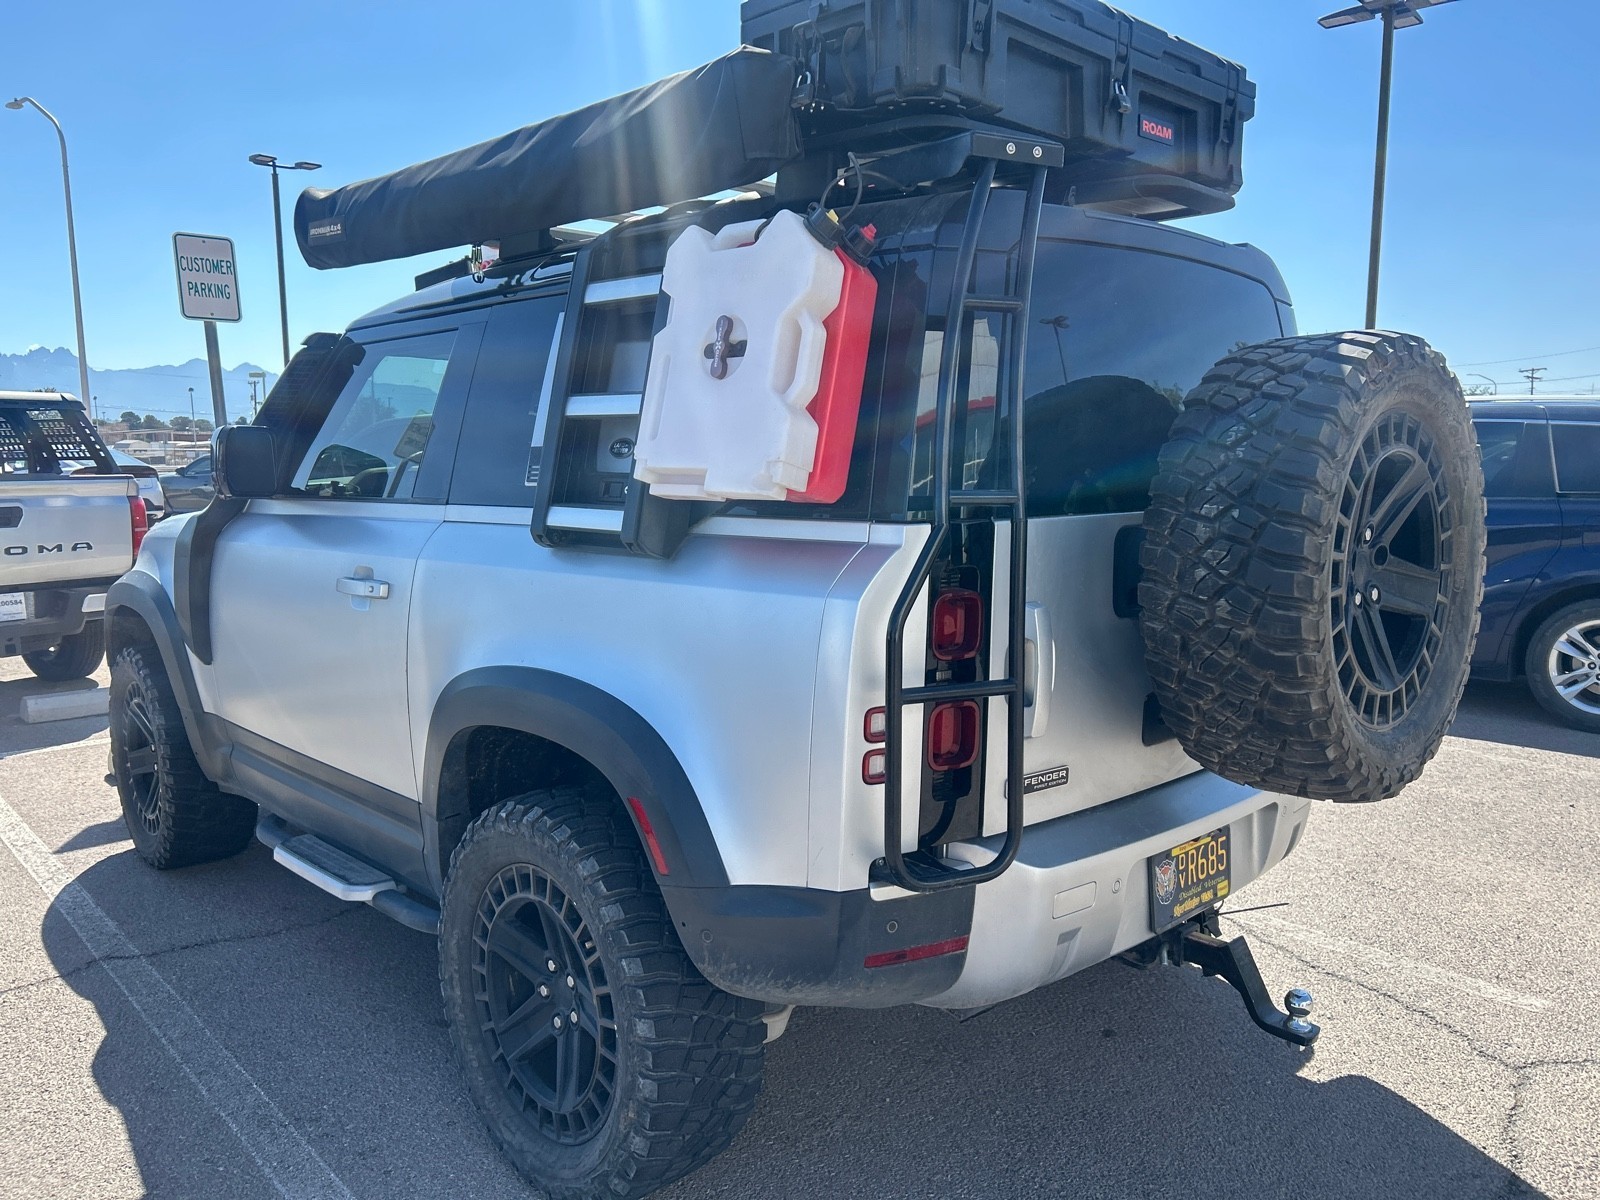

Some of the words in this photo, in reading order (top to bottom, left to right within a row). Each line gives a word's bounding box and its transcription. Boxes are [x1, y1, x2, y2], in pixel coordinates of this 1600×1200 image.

[1142, 119, 1173, 140] ROAM
[179, 255, 233, 275] CUSTOMER
[187, 281, 231, 300] PARKING
